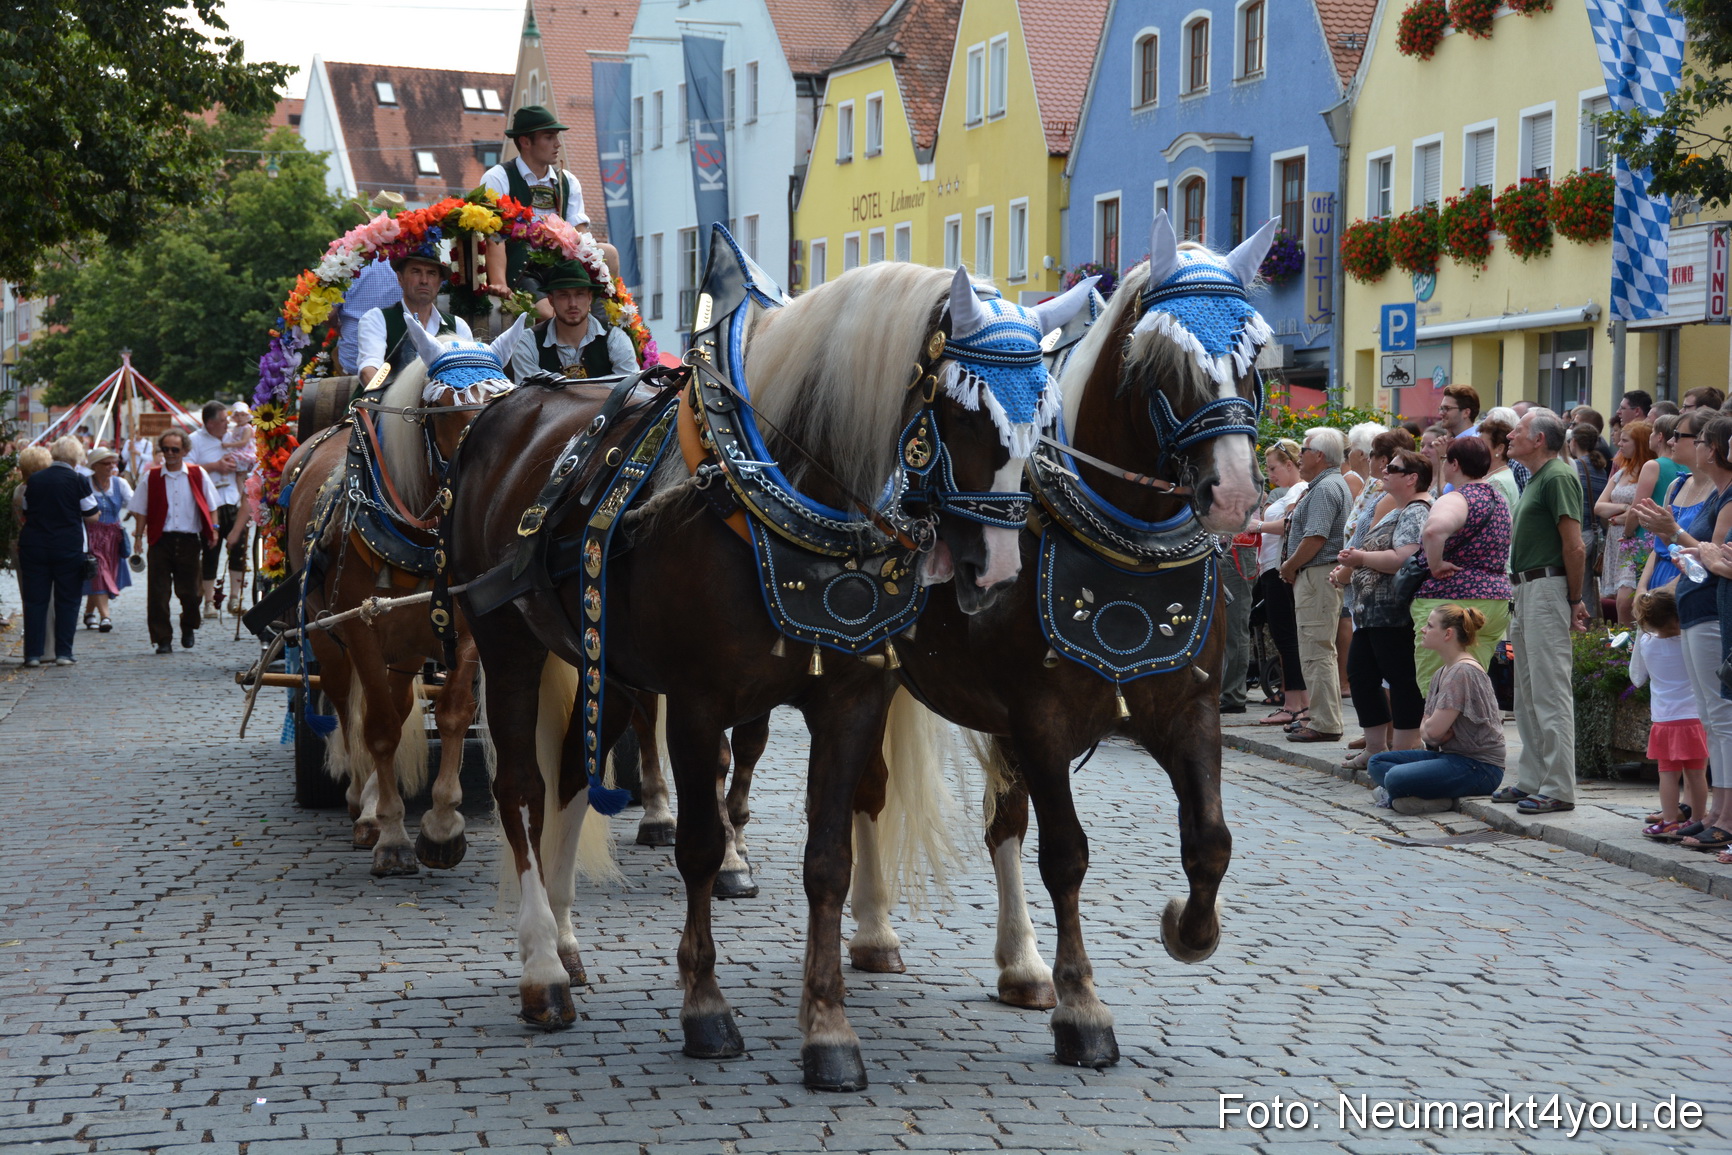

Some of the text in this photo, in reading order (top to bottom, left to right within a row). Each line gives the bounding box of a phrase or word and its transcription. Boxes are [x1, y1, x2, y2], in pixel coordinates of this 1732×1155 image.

[601, 139, 628, 208] K&L
[695, 119, 723, 191] K&L
[852, 186, 926, 222] HOTEL Lehmeier
[1312, 194, 1334, 214] CAFÉ
[1312, 217, 1331, 312] WITTL
[1672, 265, 1694, 286] KINO
[1711, 227, 1726, 316] KINO
[1388, 309, 1408, 347] P
